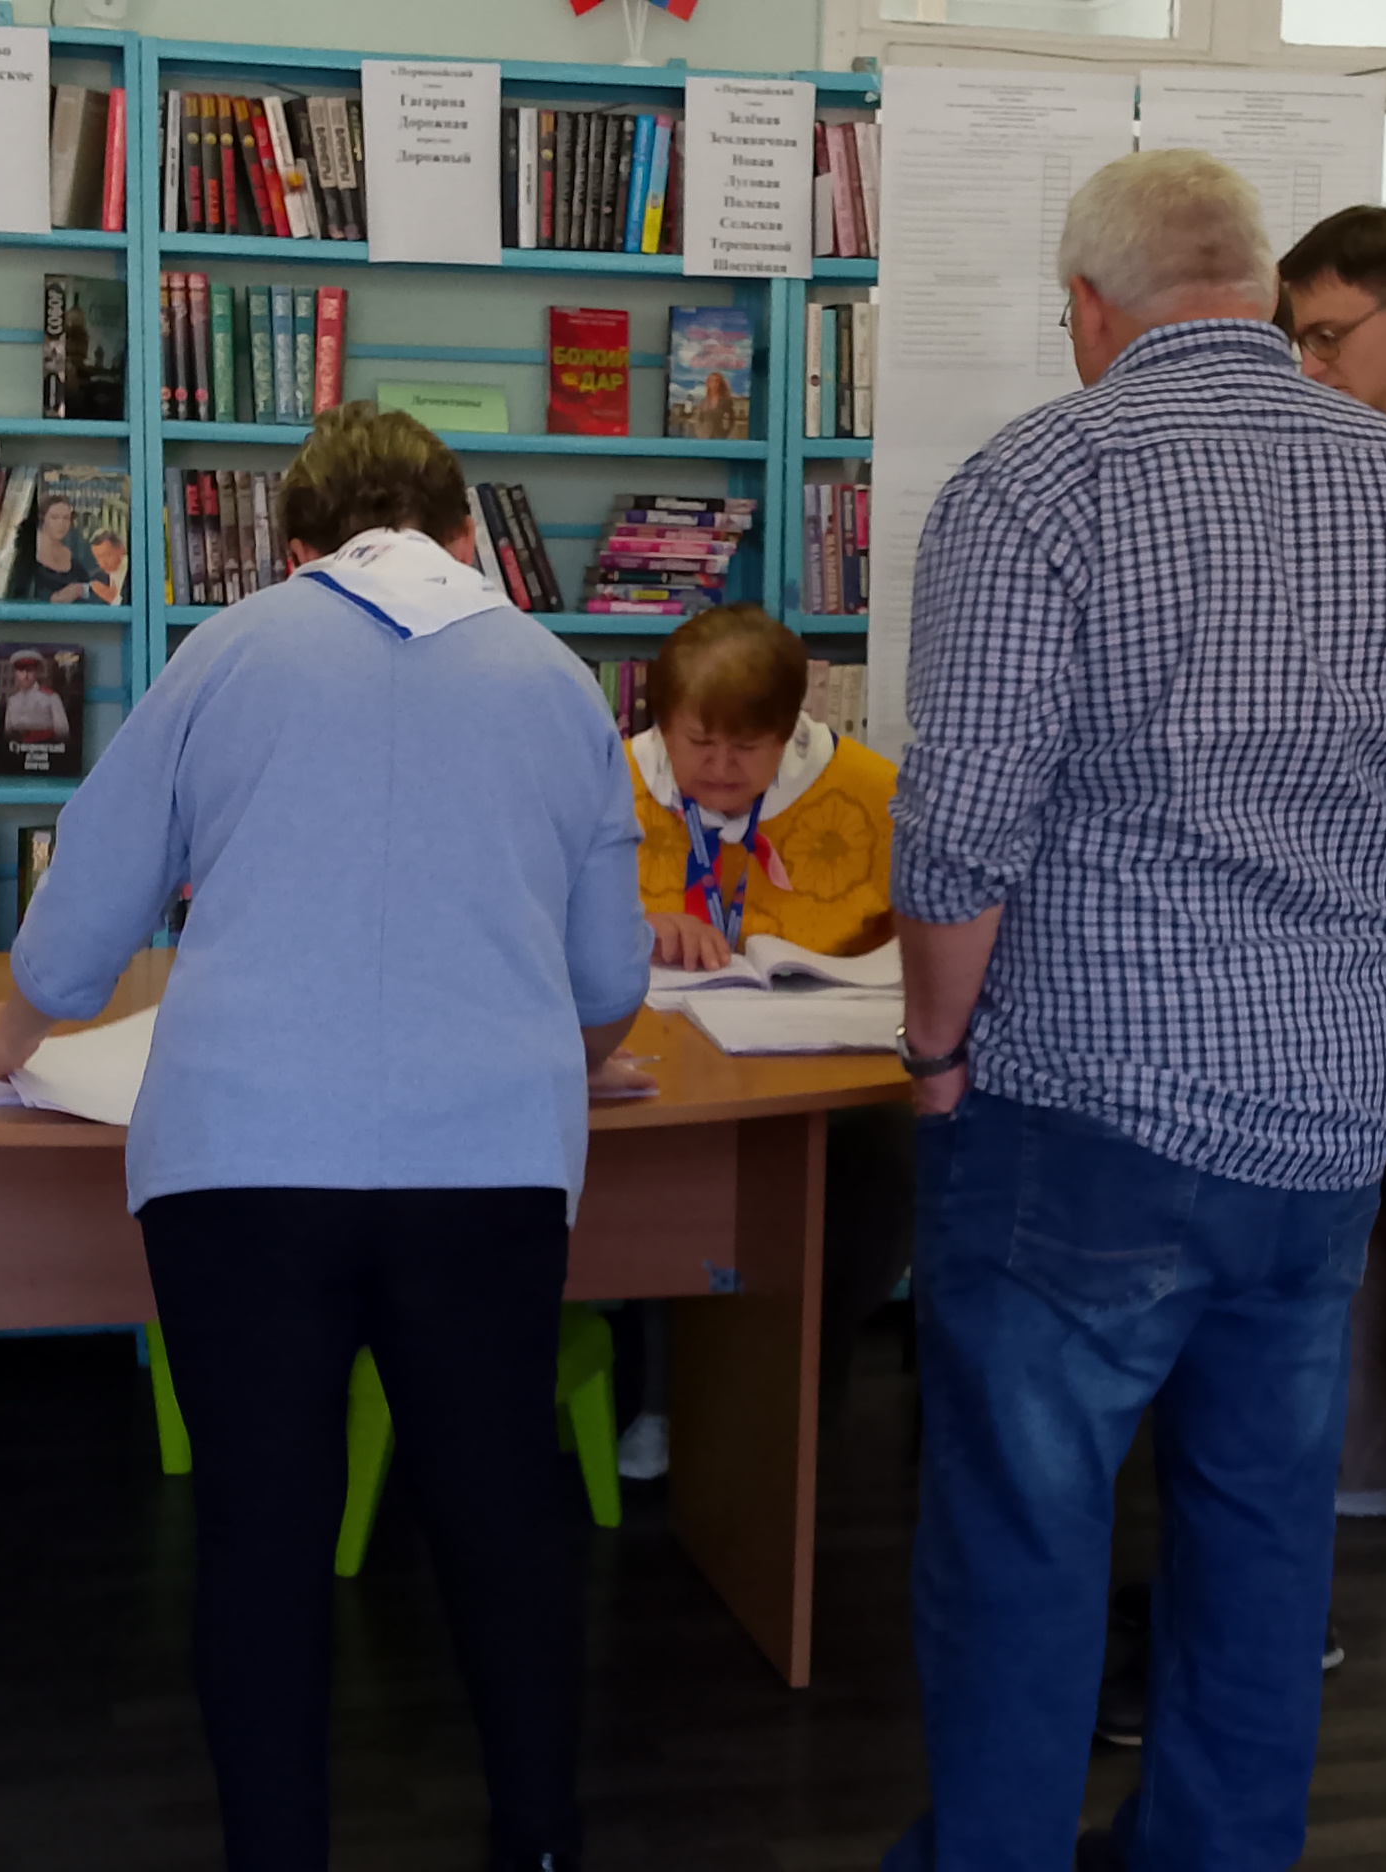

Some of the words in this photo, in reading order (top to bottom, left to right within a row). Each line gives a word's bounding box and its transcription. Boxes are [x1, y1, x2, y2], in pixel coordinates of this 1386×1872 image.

[400, 94, 465, 110] Гагарина
[397, 115, 469, 131] Дорожная
[729, 111, 781, 125] Зелёная
[710, 131, 797, 148] Земляничная
[396, 149, 472, 166] Дорожный
[733, 154, 774, 167] Новая
[724, 175, 780, 189] Луговая
[724, 196, 781, 209] Полевая
[719, 217, 783, 231] Сельская
[711, 237, 792, 253] Терешковой
[714, 258, 788, 273] Шоссейная
[553, 346, 628, 368] БОЖИЙ
[579, 373, 623, 394] ДАР
